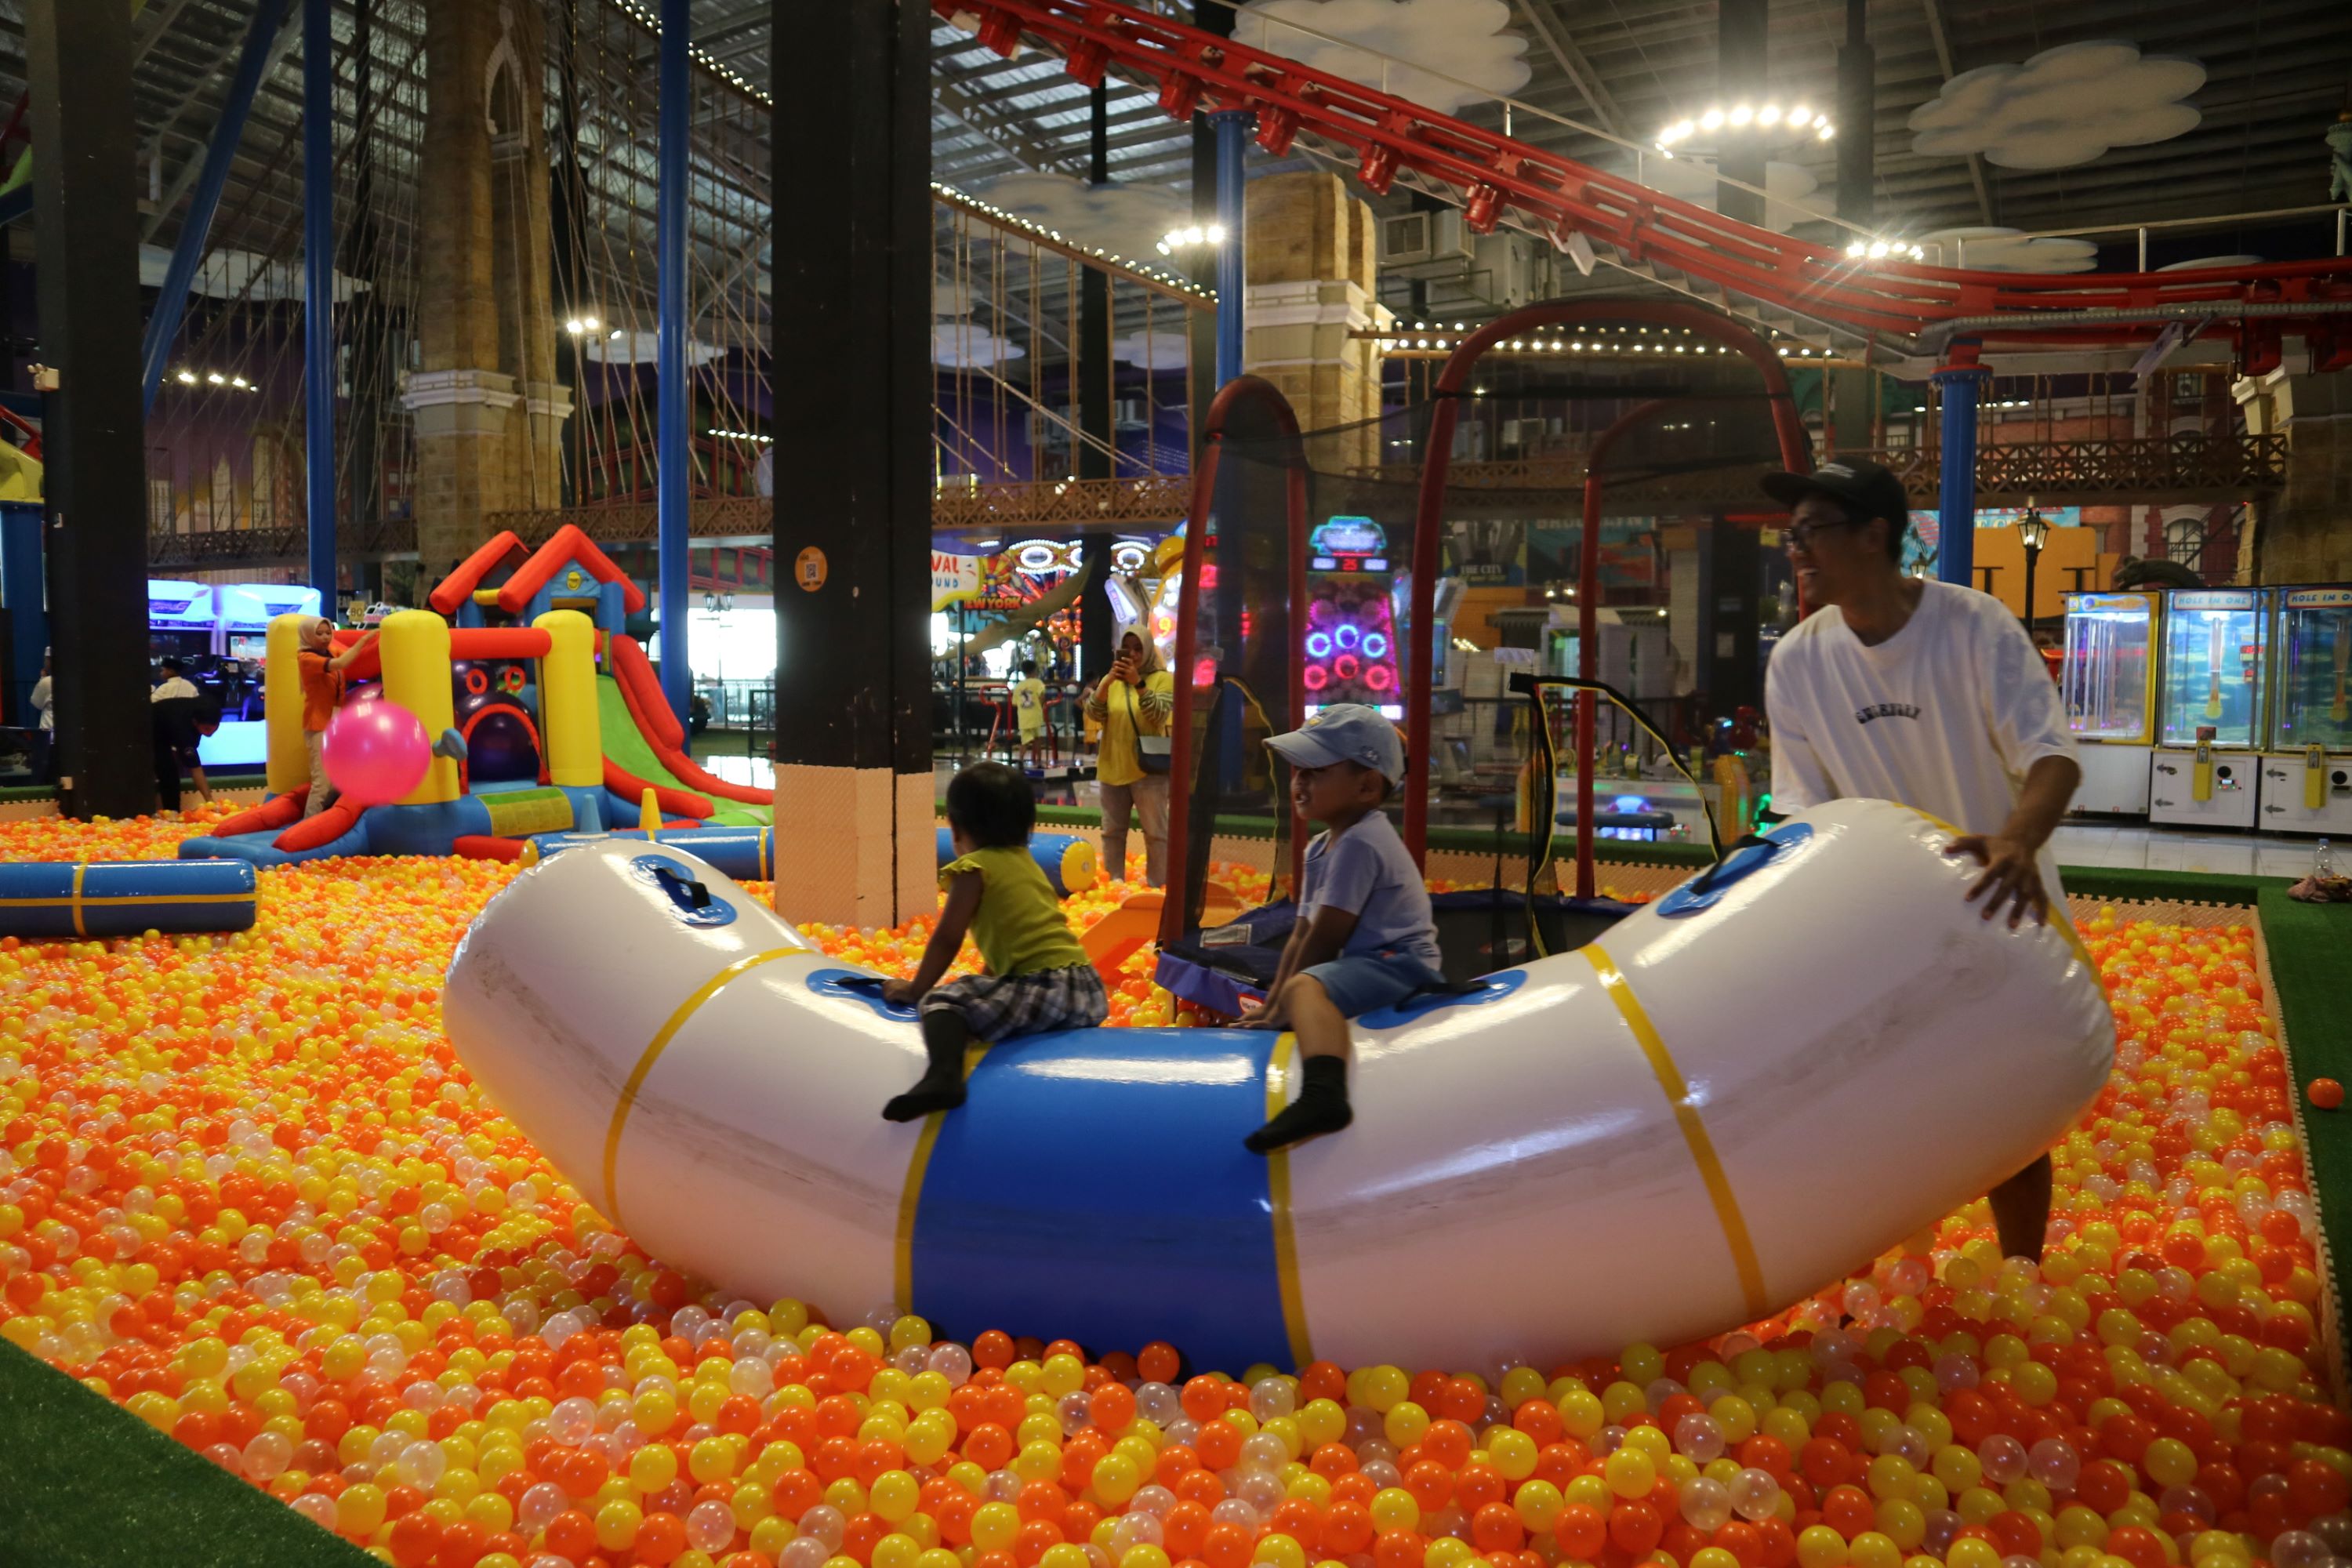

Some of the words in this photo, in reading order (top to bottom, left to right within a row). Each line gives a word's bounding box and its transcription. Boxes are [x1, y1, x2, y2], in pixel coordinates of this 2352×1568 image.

[987, 597, 1022, 609] YORK
[2292, 594, 2317, 603] HOLE
[350, 608, 364, 617] 80
